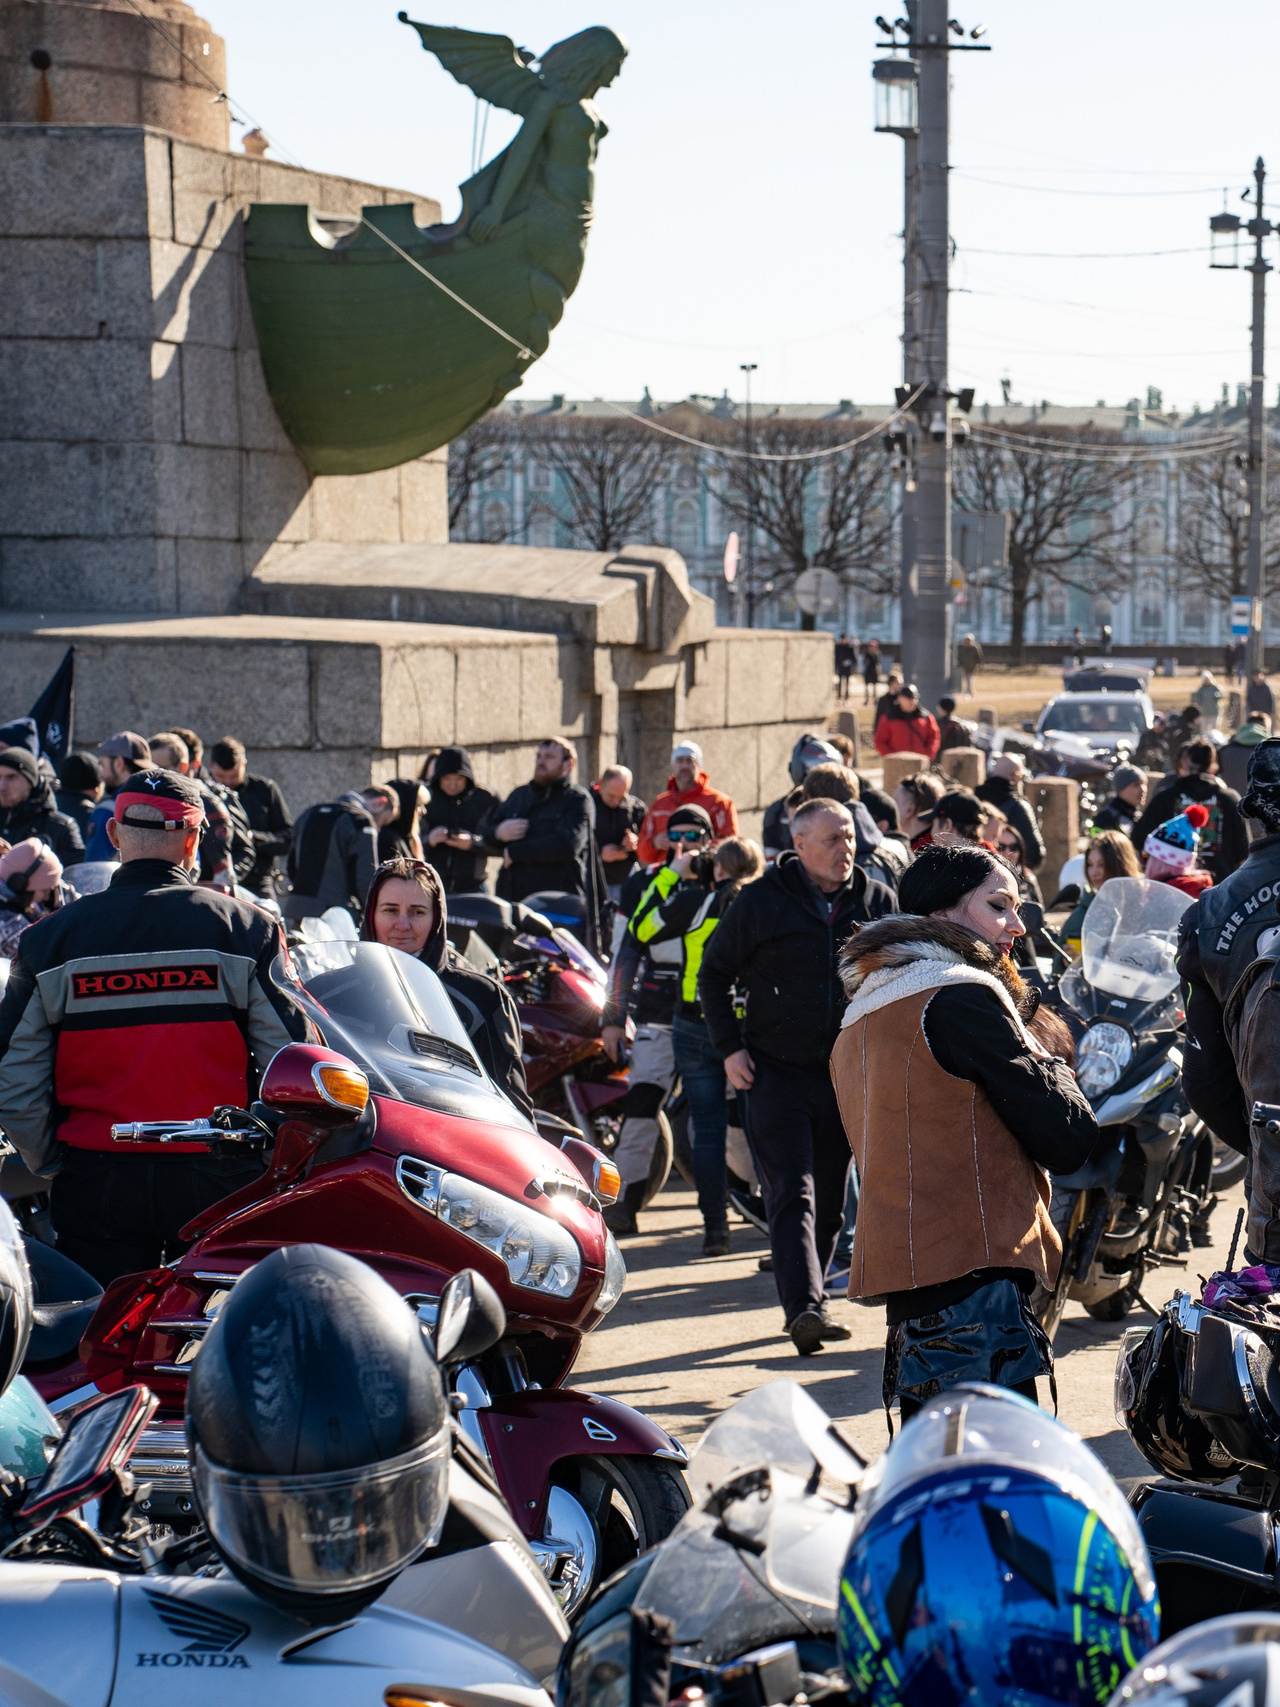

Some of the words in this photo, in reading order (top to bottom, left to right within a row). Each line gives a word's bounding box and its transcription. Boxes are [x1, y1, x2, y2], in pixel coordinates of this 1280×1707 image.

[1216, 911, 1244, 951] THE
[76, 970, 215, 994] HONDA
[136, 1652, 252, 1669] HONDA
